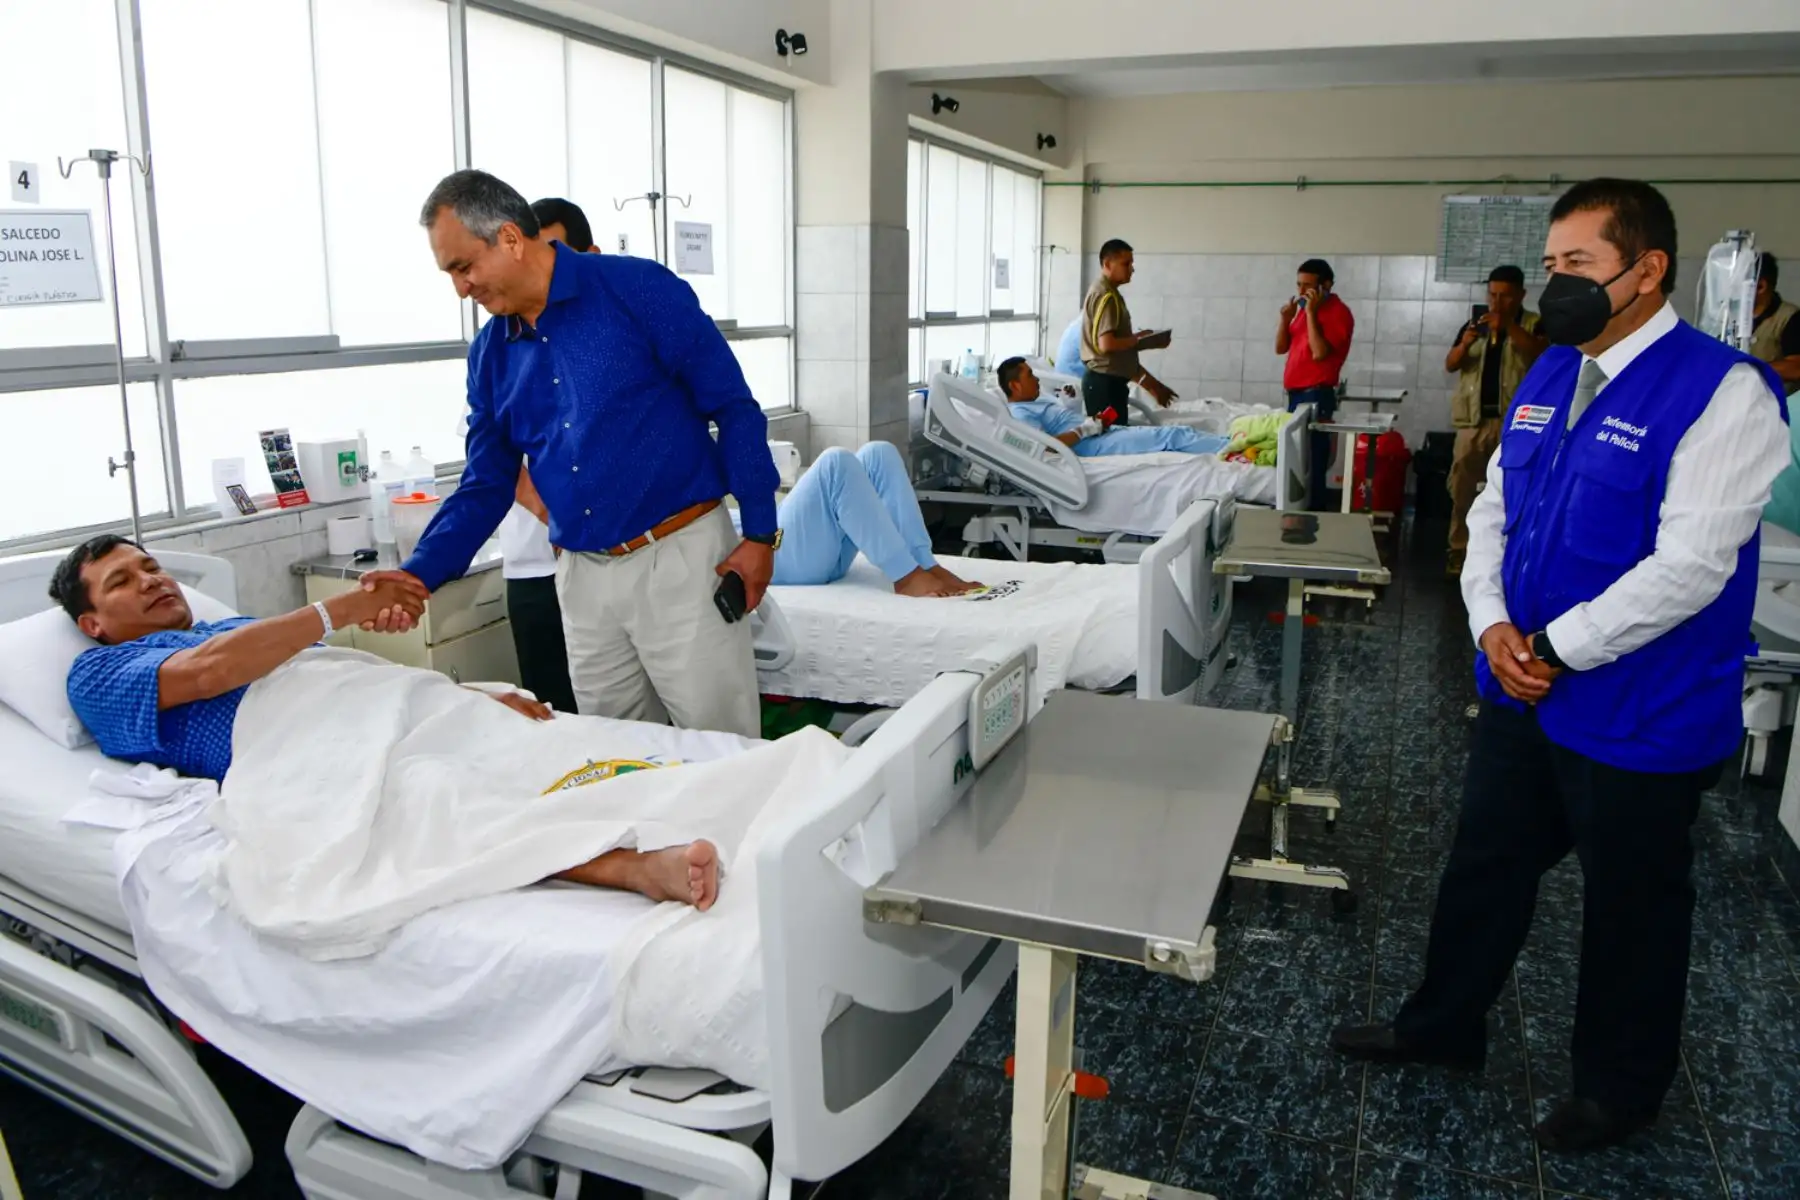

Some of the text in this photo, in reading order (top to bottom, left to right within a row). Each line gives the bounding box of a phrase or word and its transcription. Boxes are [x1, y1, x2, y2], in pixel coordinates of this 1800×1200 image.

[17, 169, 31, 189] 4
[1, 228, 61, 240] SALCEDO
[620, 239, 626, 251] 3
[0, 249, 84, 263] OLINA JOSE L.
[1596, 430, 1640, 452] del Policía
